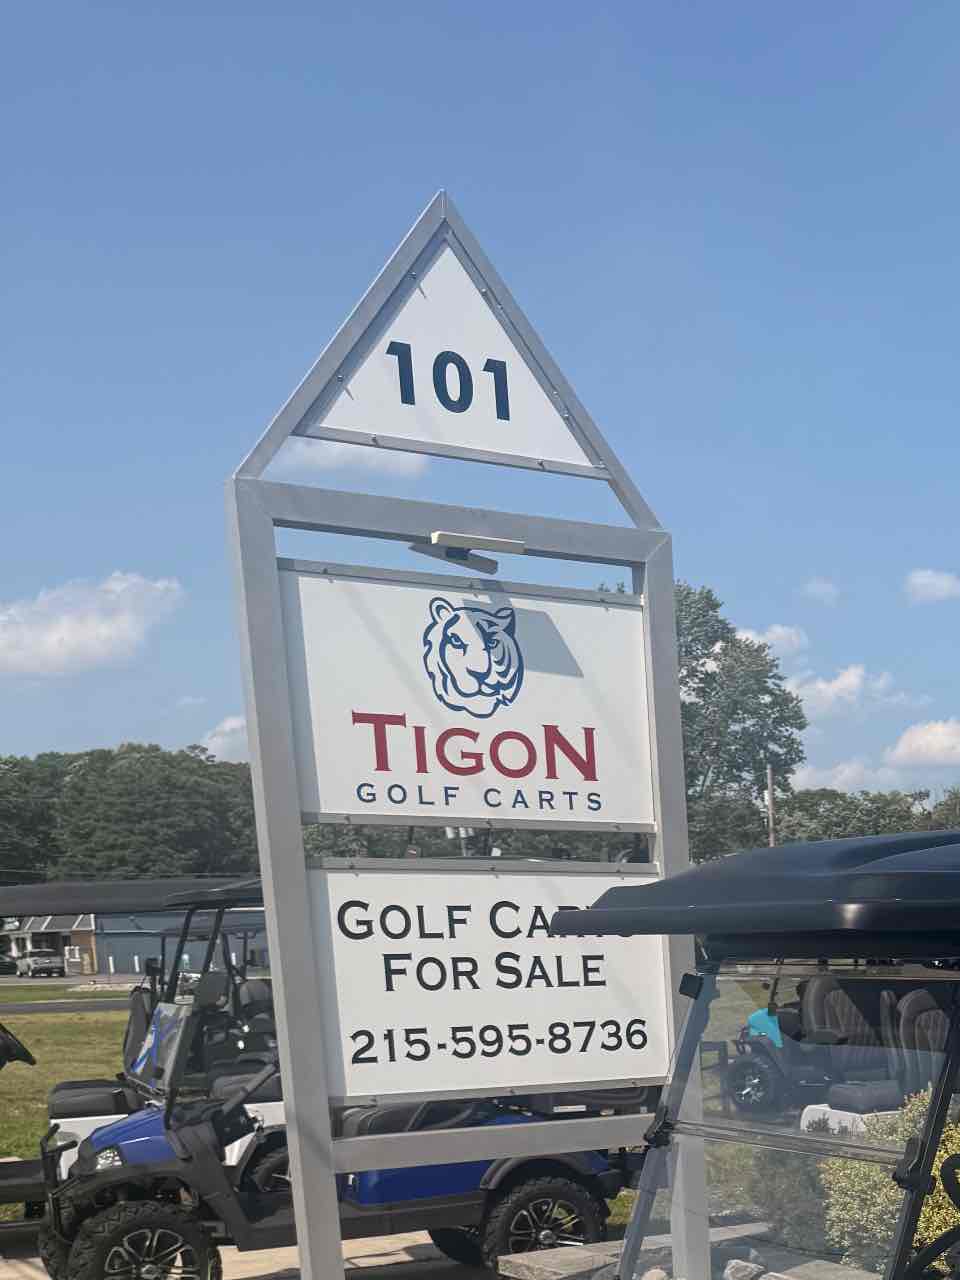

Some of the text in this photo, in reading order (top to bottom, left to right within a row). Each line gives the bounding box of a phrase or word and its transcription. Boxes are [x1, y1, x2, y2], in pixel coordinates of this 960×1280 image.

[386, 341, 510, 421] 101
[352, 710, 599, 782] TIGON
[356, 783, 602, 812] GOLF CARTS
[337, 900, 472, 940] GOLF
[381, 952, 607, 992] FOR SALE
[350, 1018, 648, 1064] 215-595-8736
